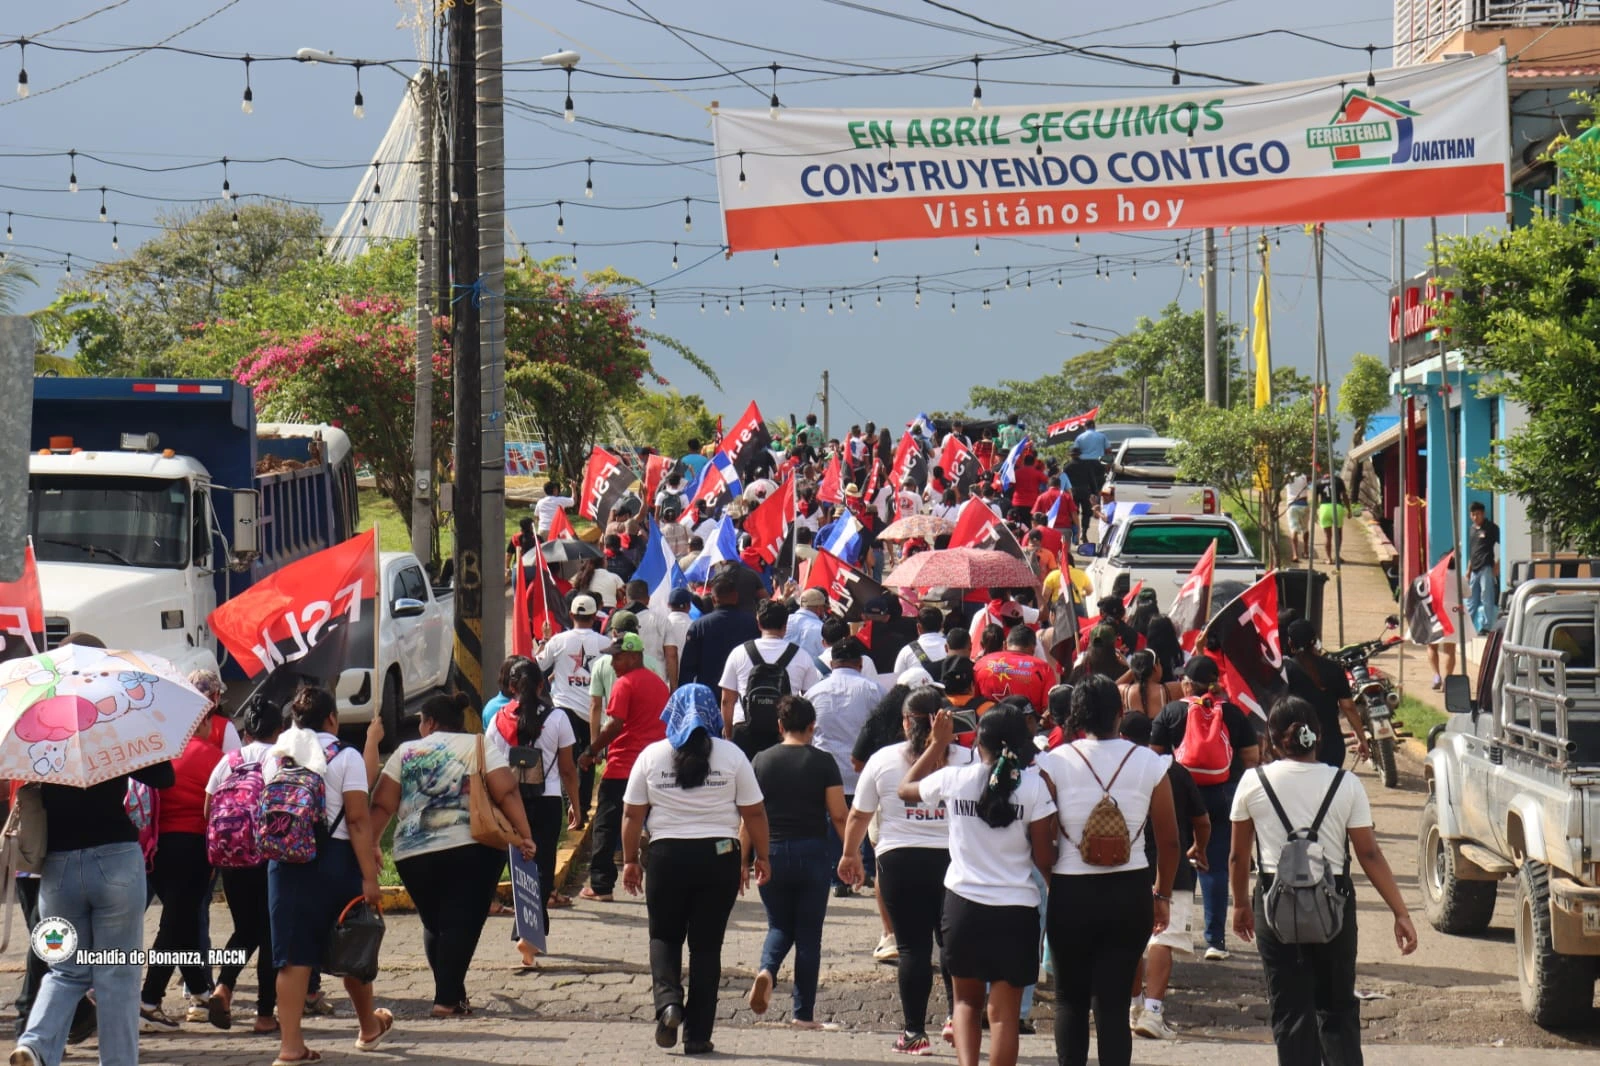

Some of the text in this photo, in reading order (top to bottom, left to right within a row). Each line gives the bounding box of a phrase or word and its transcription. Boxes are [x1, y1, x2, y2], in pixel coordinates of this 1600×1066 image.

[848, 99, 1224, 149] EN ABRIL SEGUIMOS
[1309, 123, 1389, 145] FERRETERIA
[800, 139, 1290, 197] CONSTRUYENDO CONTIGO
[924, 194, 1184, 229] Visitános hoy
[568, 676, 591, 687] FSL
[87, 734, 164, 772] SWEET
[905, 808, 945, 821] FSLN
